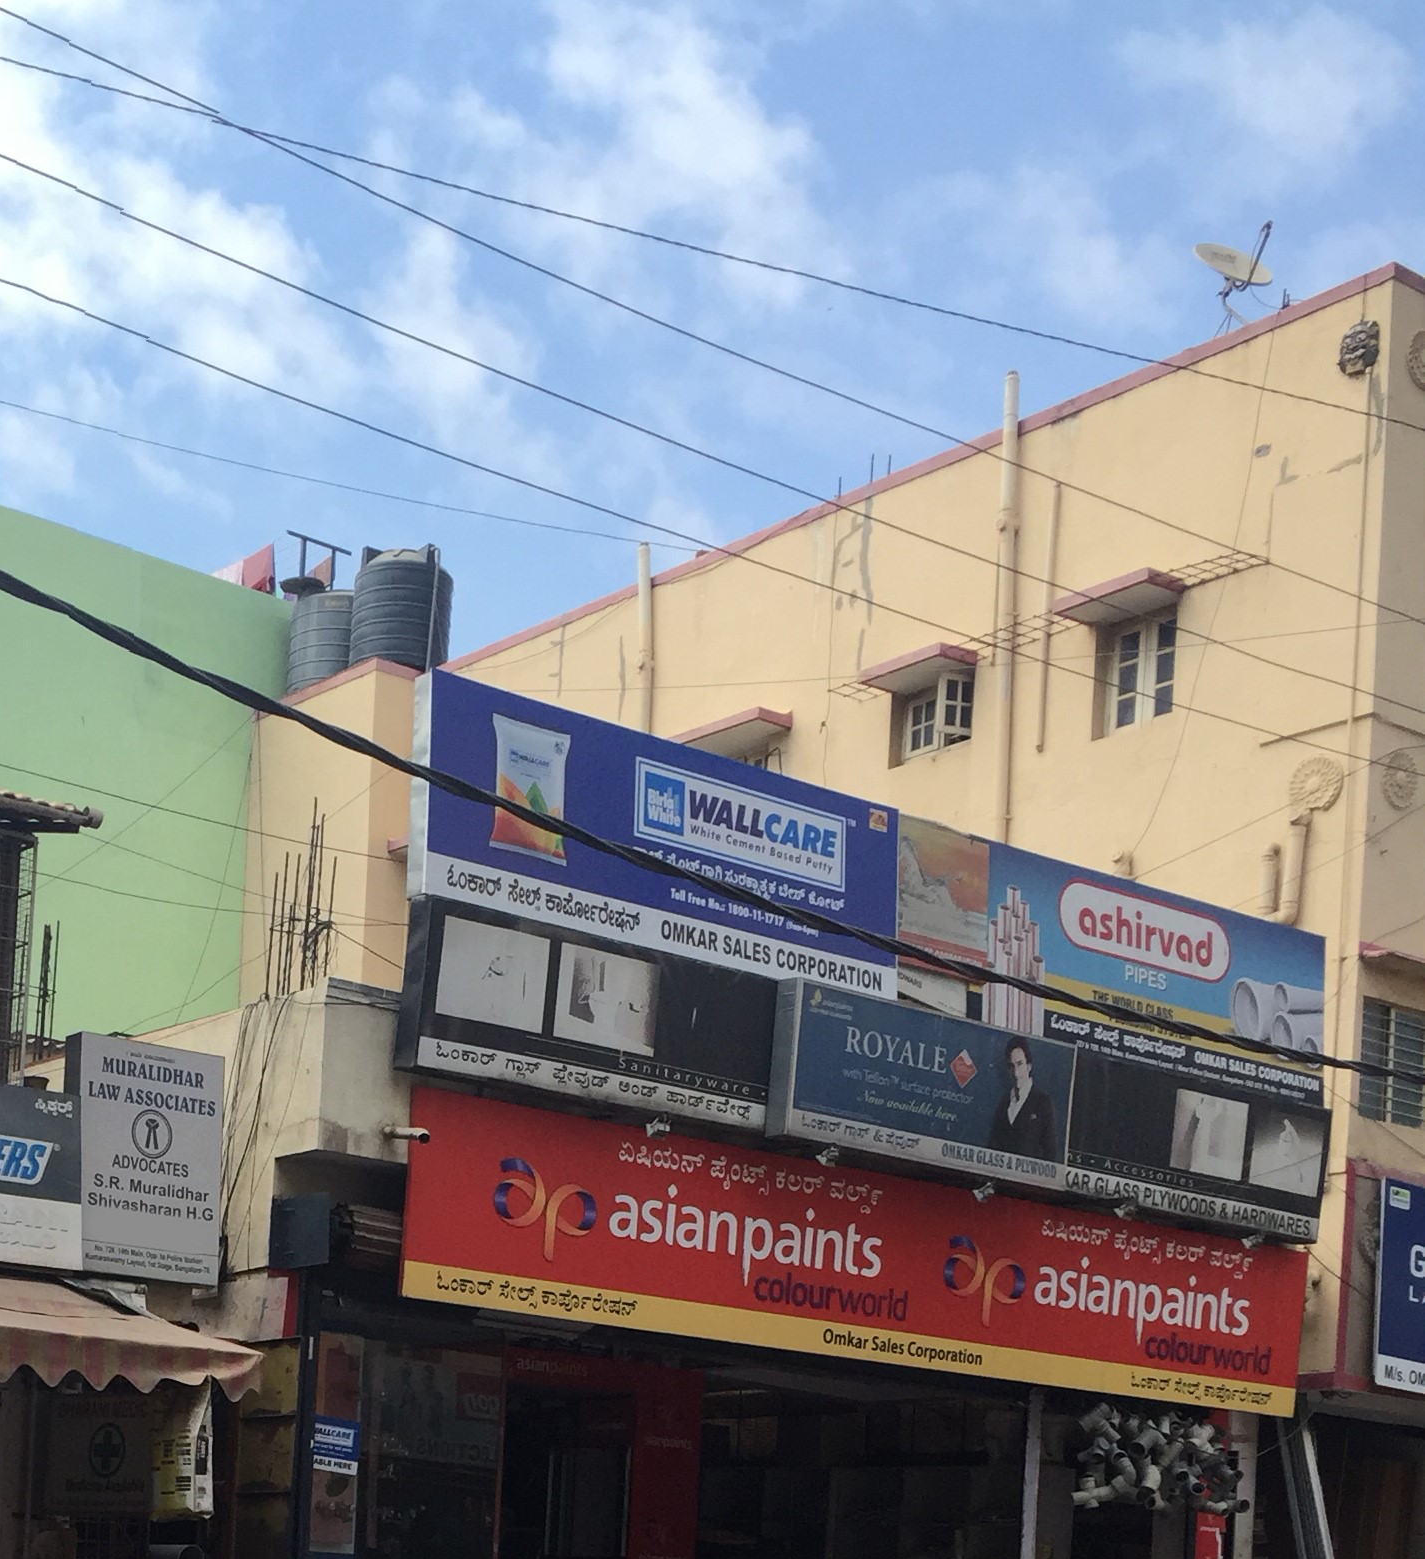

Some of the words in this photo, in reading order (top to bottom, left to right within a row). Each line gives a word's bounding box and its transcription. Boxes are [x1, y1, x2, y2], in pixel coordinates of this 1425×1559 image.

[647, 804, 682, 828] White
[689, 789, 838, 859] WALLCARE
[690, 824, 722, 842] White
[726, 834, 766, 854] Cement
[770, 847, 802, 865] Based
[806, 857, 834, 876] Putty
[670, 887, 686, 902] Toll
[660, 919, 719, 952] OMKAR
[722, 938, 772, 965] SALES
[776, 949, 883, 992] CORPORATION
[1078, 905, 1214, 968] ashirvad
[1124, 964, 1168, 992] PIPES
[845, 1026, 947, 1074] ROYALE
[102, 1056, 204, 1089] MURALIDHAR
[618, 1056, 751, 1096] Sanitaryware
[1194, 1050, 1227, 1070] OMKAR
[1228, 1060, 1257, 1077] SALES
[1258, 1062, 1320, 1092] CORPORATION
[89, 1080, 121, 1101] LAW
[124, 1087, 216, 1118] ASSOCIATES
[112, 1154, 189, 1178] ADVOCATES
[941, 1142, 976, 1163] OMKAR
[976, 1150, 1005, 1170] GLASS
[1105, 1159, 1194, 1188] Accessories
[87, 1192, 181, 1218] Shivasharan
[186, 1206, 214, 1221] H.G
[93, 1173, 124, 1190] S.R.
[129, 1179, 209, 1202] Muralidhar
[1095, 1177, 1139, 1202] GLASS
[1144, 1187, 1216, 1219] PLYWOODS
[1220, 1201, 1228, 1219] &
[1232, 1203, 1311, 1237] HARDWARES
[608, 1183, 883, 1287] asianpaints
[753, 1273, 909, 1322] colourworld
[1034, 1255, 1251, 1345] asianpaints
[822, 1328, 869, 1350] Omkar
[871, 1335, 904, 1355] Sales
[907, 1341, 983, 1366] Corporation
[1144, 1333, 1271, 1375] colourworld
[1384, 1364, 1406, 1383] M/s.
